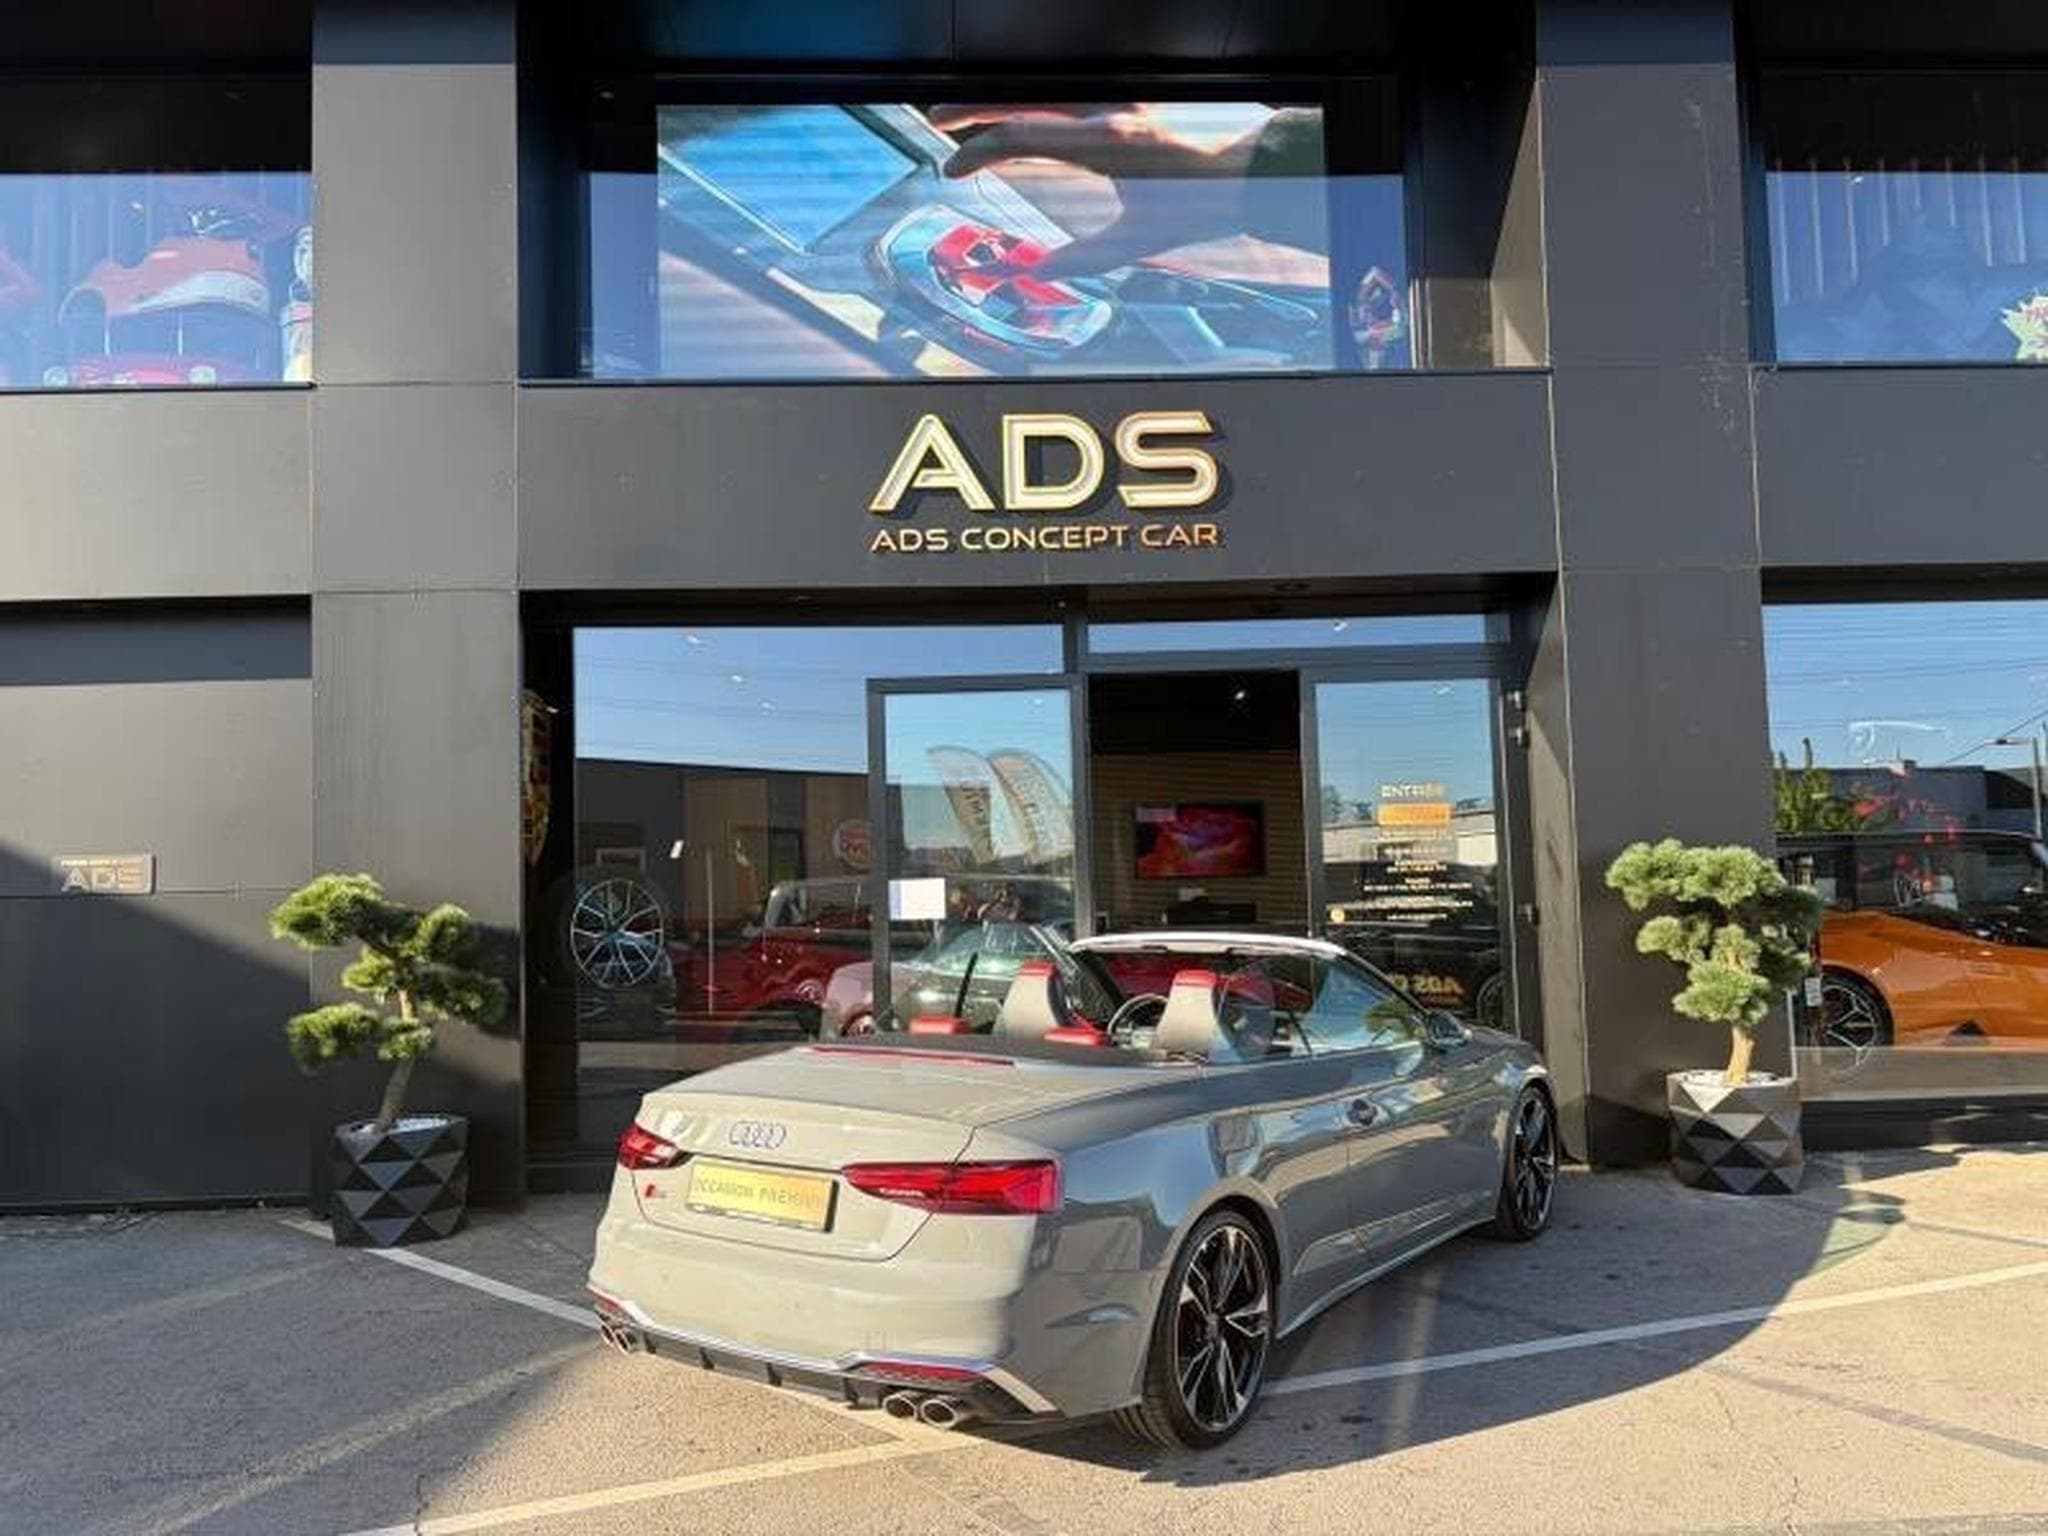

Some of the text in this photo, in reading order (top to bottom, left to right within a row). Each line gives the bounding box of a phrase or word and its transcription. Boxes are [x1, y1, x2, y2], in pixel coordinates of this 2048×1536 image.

[868, 411, 1219, 512] ADS
[870, 523, 1219, 552] ADS CONCEPT CAR
